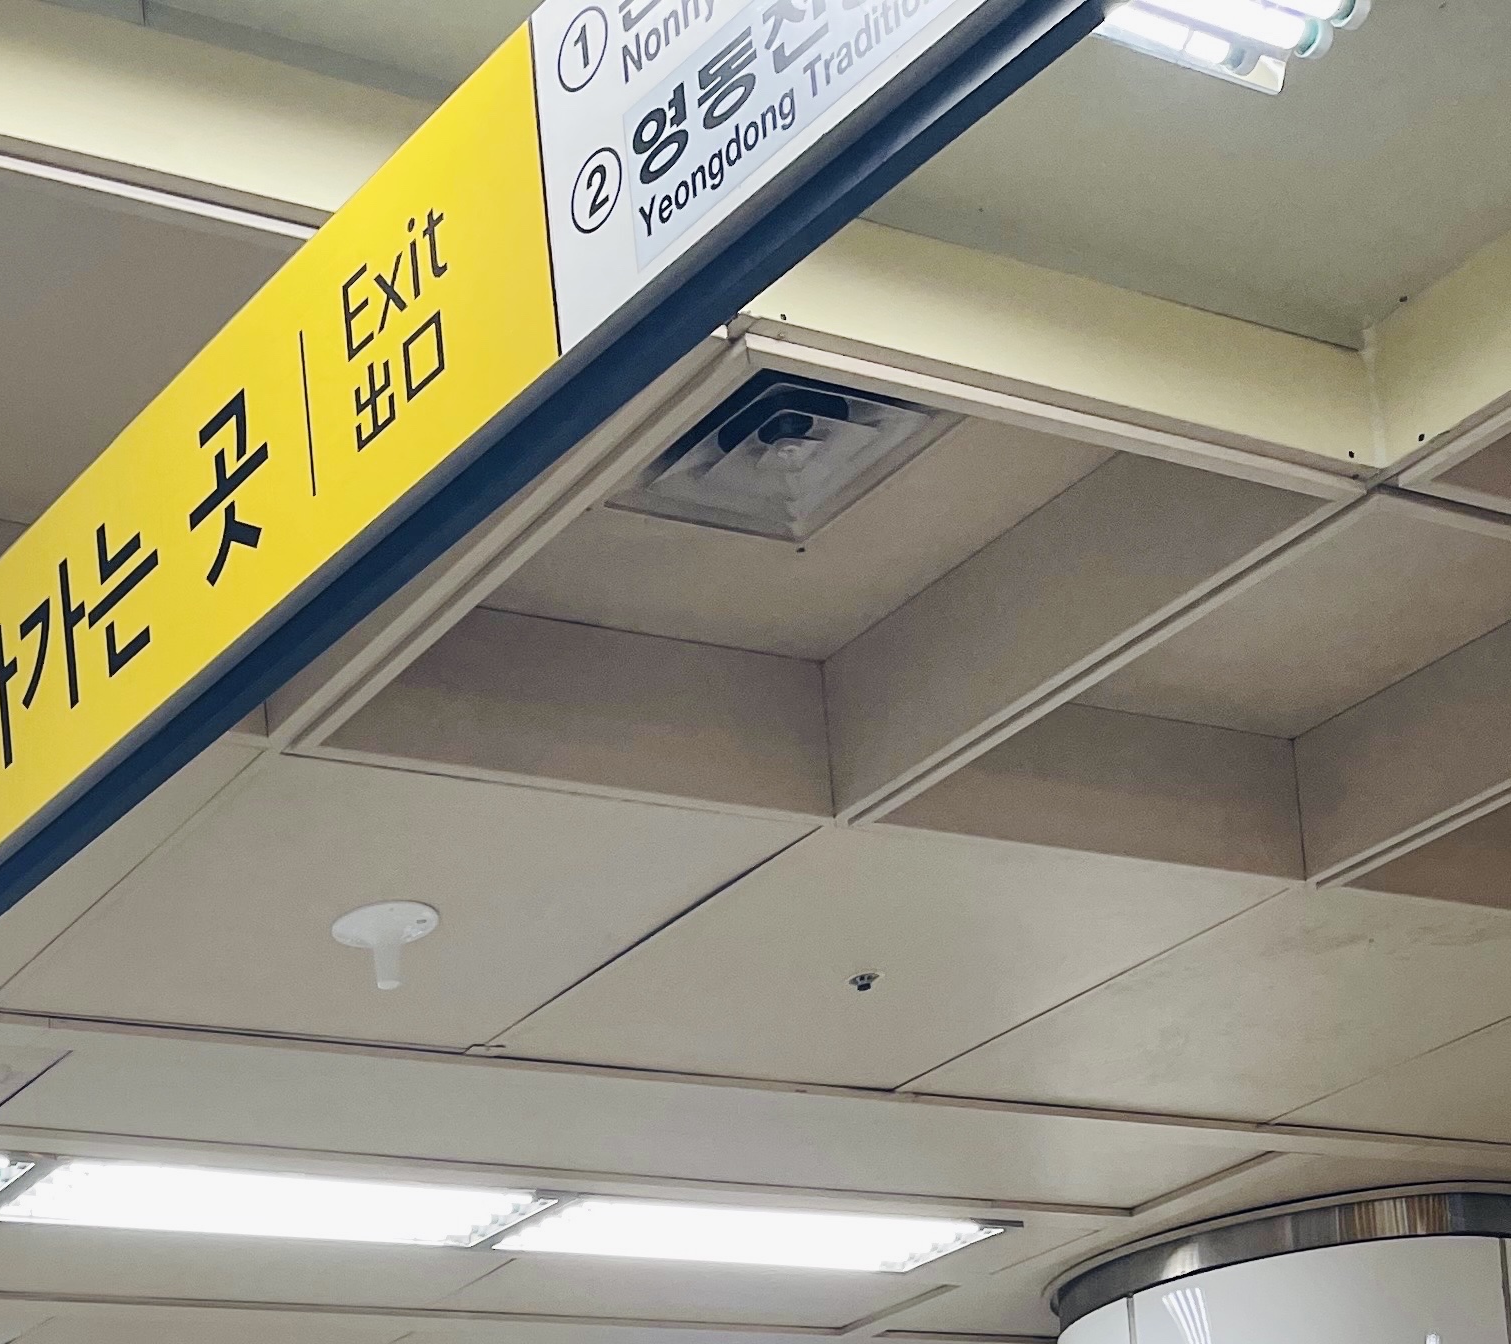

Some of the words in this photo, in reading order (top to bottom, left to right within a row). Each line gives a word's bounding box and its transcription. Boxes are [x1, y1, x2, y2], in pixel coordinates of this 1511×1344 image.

[638, 87, 797, 237] Yeongdong
[802, 0, 931, 98] Traditio
[341, 208, 448, 362] Exit
[354, 310, 445, 452] 出口
[189, 388, 269, 587] 곳
